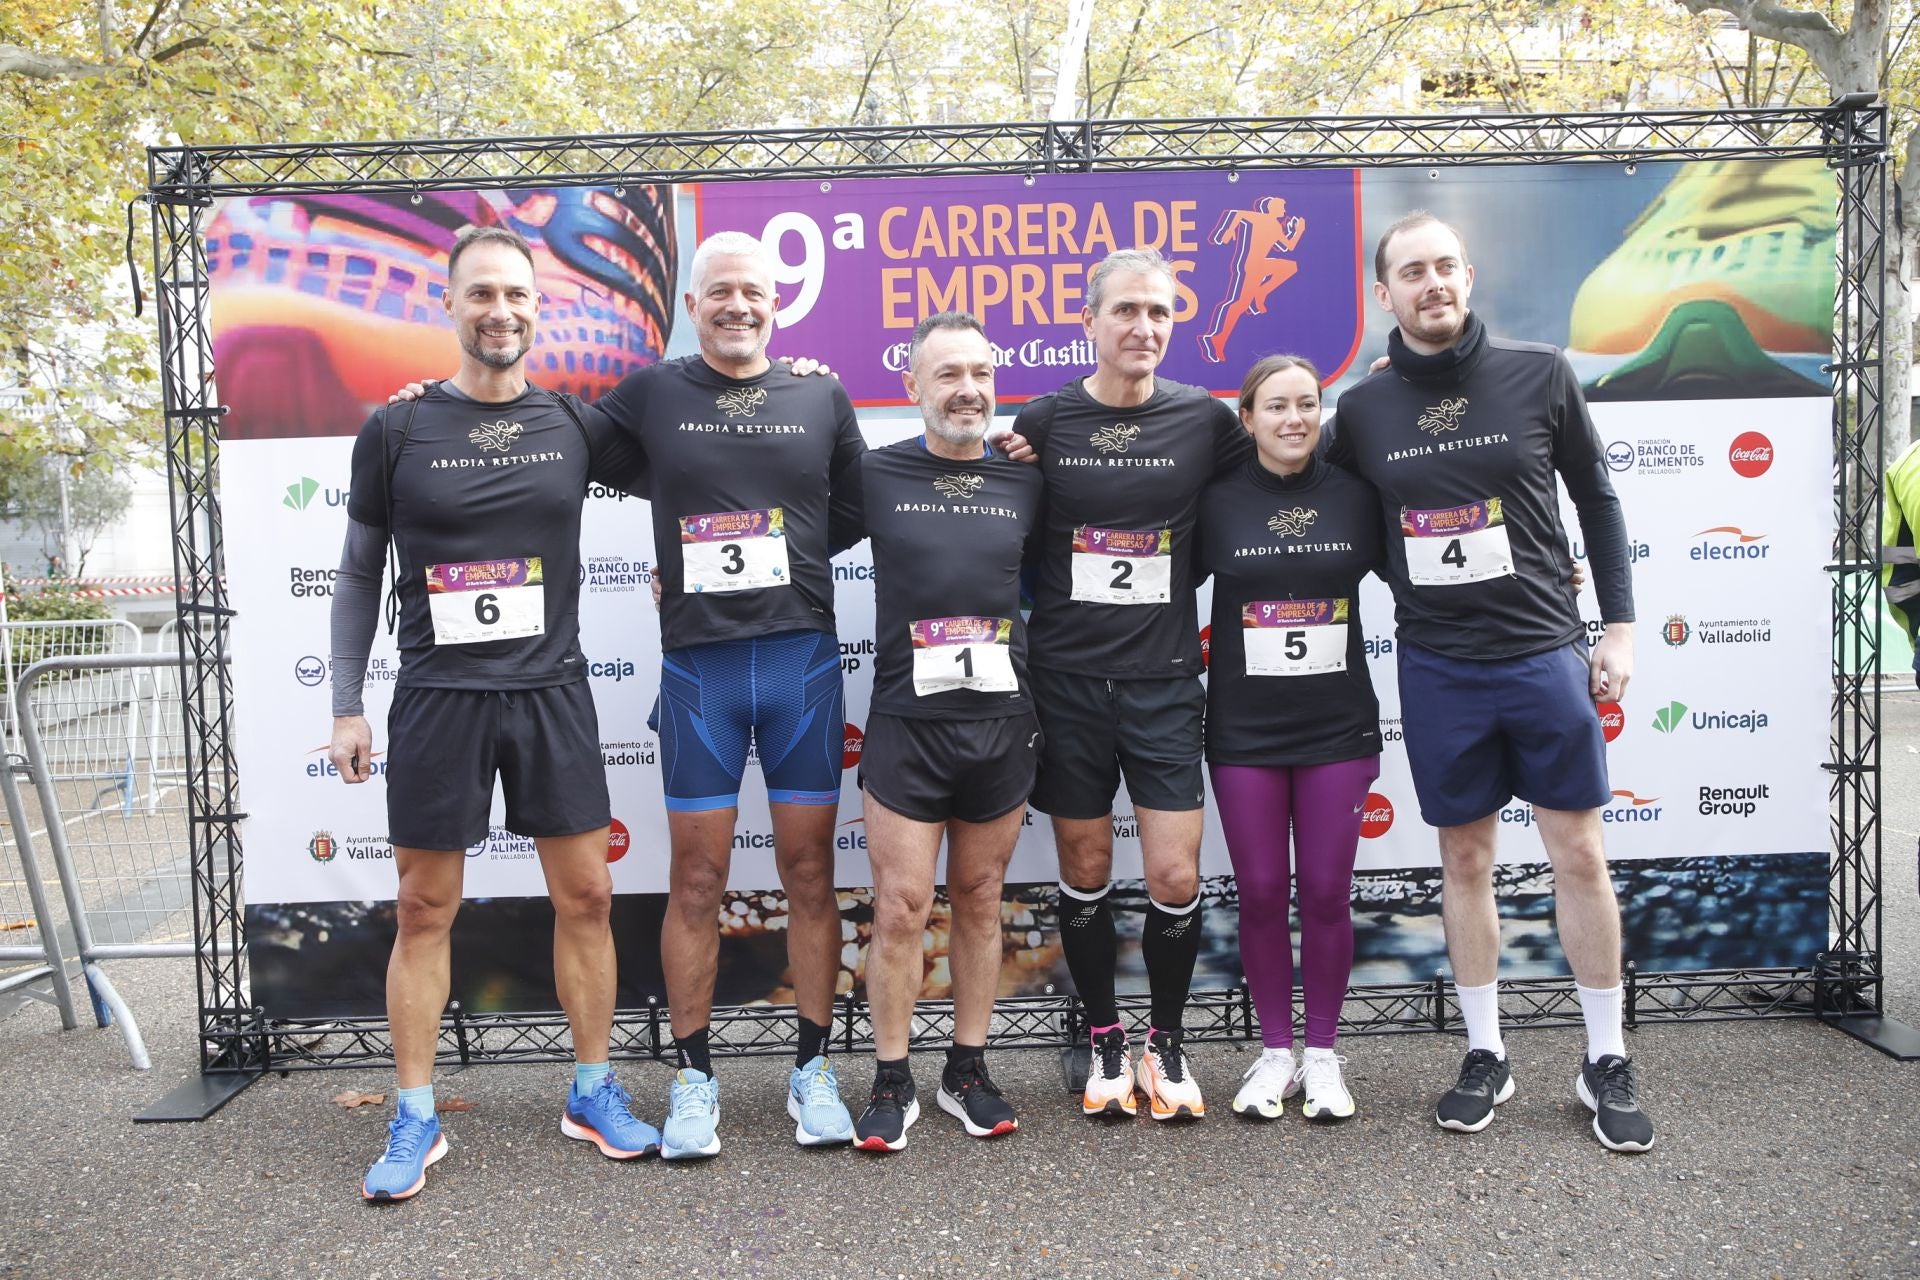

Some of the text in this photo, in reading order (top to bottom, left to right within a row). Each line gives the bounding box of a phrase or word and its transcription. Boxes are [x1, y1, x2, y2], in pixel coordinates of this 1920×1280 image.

[878, 200, 1198, 260] CARRERA DE
[881, 260, 1199, 329] EMPRES
[1019, 338, 1099, 368] Castil
[678, 422, 806, 434] ABADIA RETUERTA
[1387, 433, 1509, 463] ABADIA RETUERTA
[1638, 444, 1696, 456] BANCO DE
[430, 450, 565, 469] ABADIA RETUERTA
[1058, 457, 1176, 467] ABADIA RETUERTA
[1638, 456, 1705, 468] ALIMENTOS
[586, 486, 630, 502] roup
[895, 503, 1018, 520] ABADIA RETUERTA
[1234, 542, 1353, 558] ABADIA RETUERTA
[1441, 538, 1467, 569] 4
[1690, 541, 1770, 560] elecnor
[720, 543, 745, 575] 3
[290, 567, 337, 582] Rena
[588, 562, 649, 574] BANCO DE
[834, 561, 877, 581] nica
[1109, 560, 1133, 590] 2
[589, 573, 654, 586] ALIMENTO
[474, 593, 501, 626] 6
[1698, 618, 1771, 629] Ayuntamiento de
[1698, 629, 1771, 644] Valladolid
[840, 639, 874, 655] ault
[1284, 630, 1308, 661] 5
[372, 659, 388, 670] DE
[585, 658, 635, 682] icaja
[955, 647, 974, 678] 1
[1692, 709, 1769, 733] Unicaja
[600, 741, 654, 750] tamiento de
[306, 758, 388, 777] eleor
[602, 752, 655, 766] ladolid
[1699, 784, 1770, 801] Renault
[1602, 808, 1662, 823] ecnor
[1699, 801, 1756, 818] Group
[490, 842, 536, 853] ALIMEN
[732, 830, 776, 849] nica
[346, 846, 393, 860] Vallad
